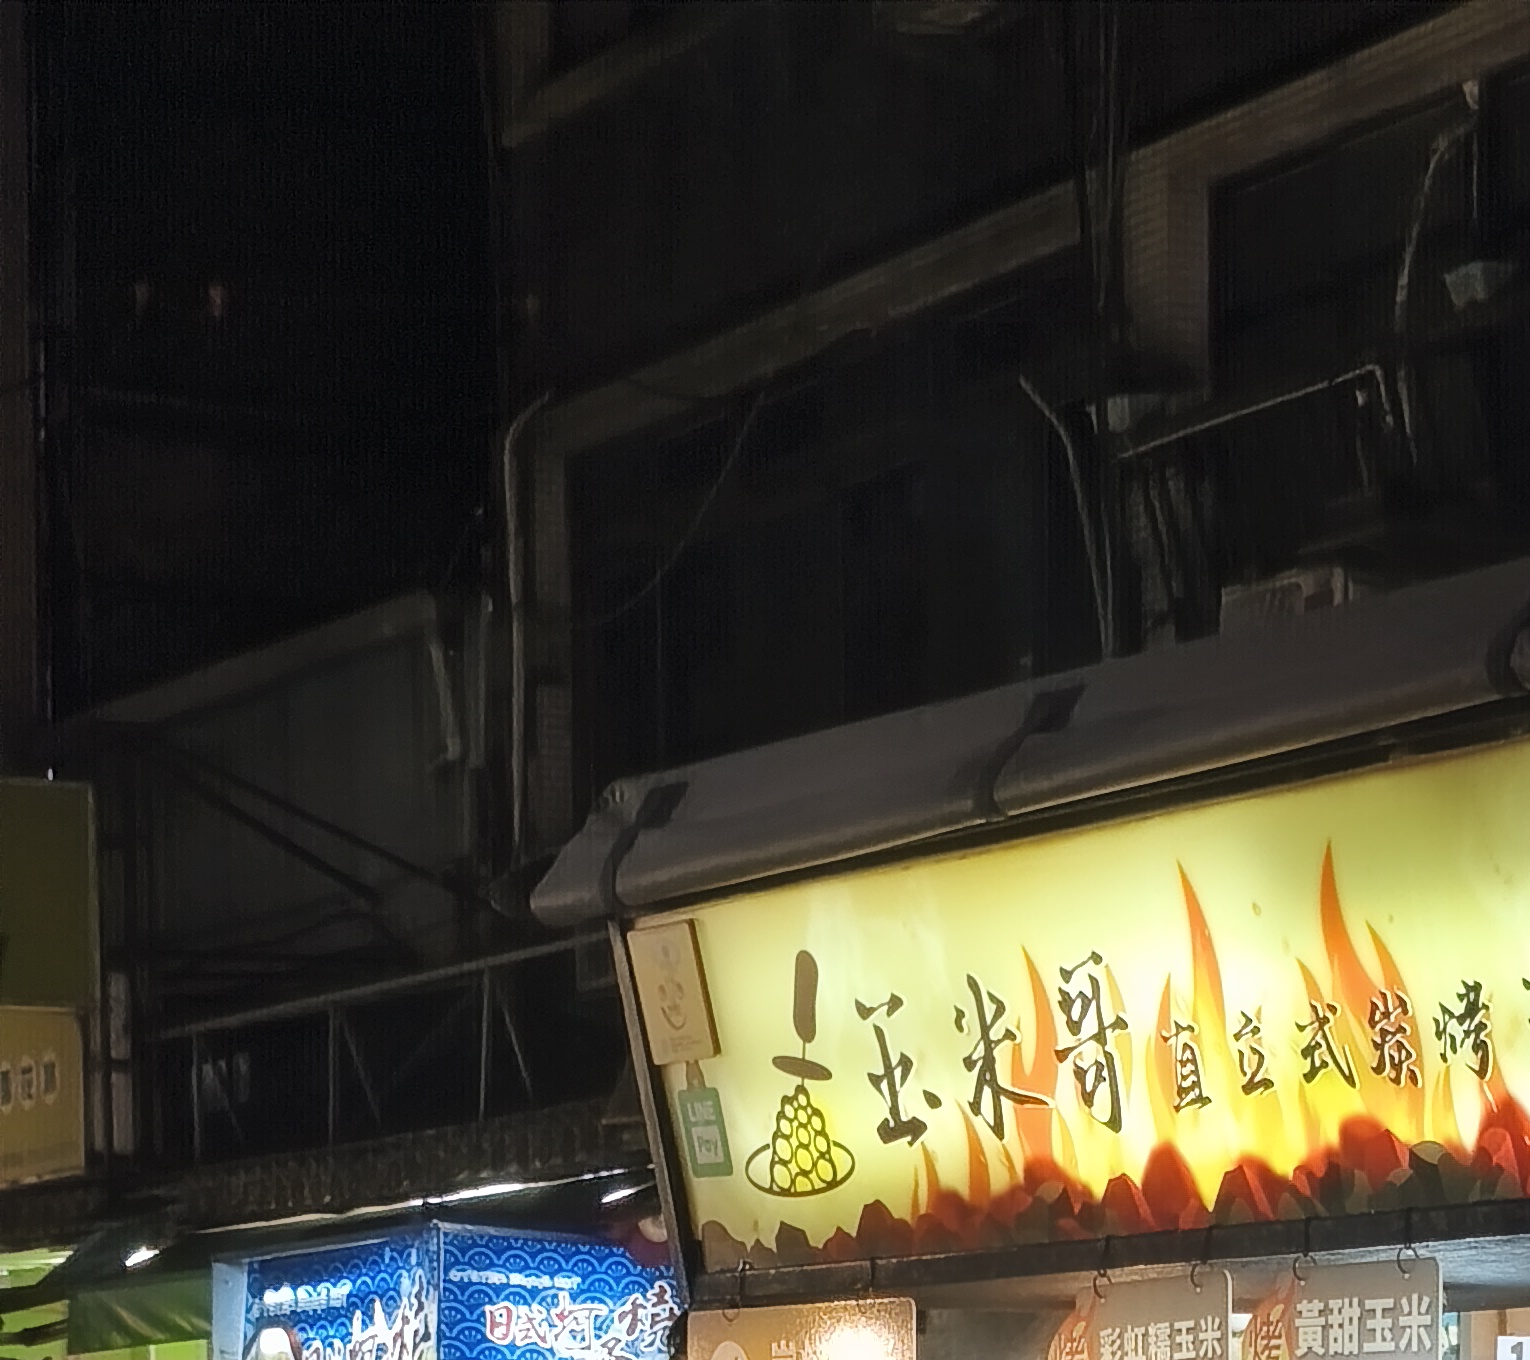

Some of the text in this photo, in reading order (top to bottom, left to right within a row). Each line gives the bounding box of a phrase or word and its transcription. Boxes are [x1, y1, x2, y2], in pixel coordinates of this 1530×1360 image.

[687, 1101, 717, 1122] LINE
[1295, 1294, 1432, 1357] 黃甜玉米
